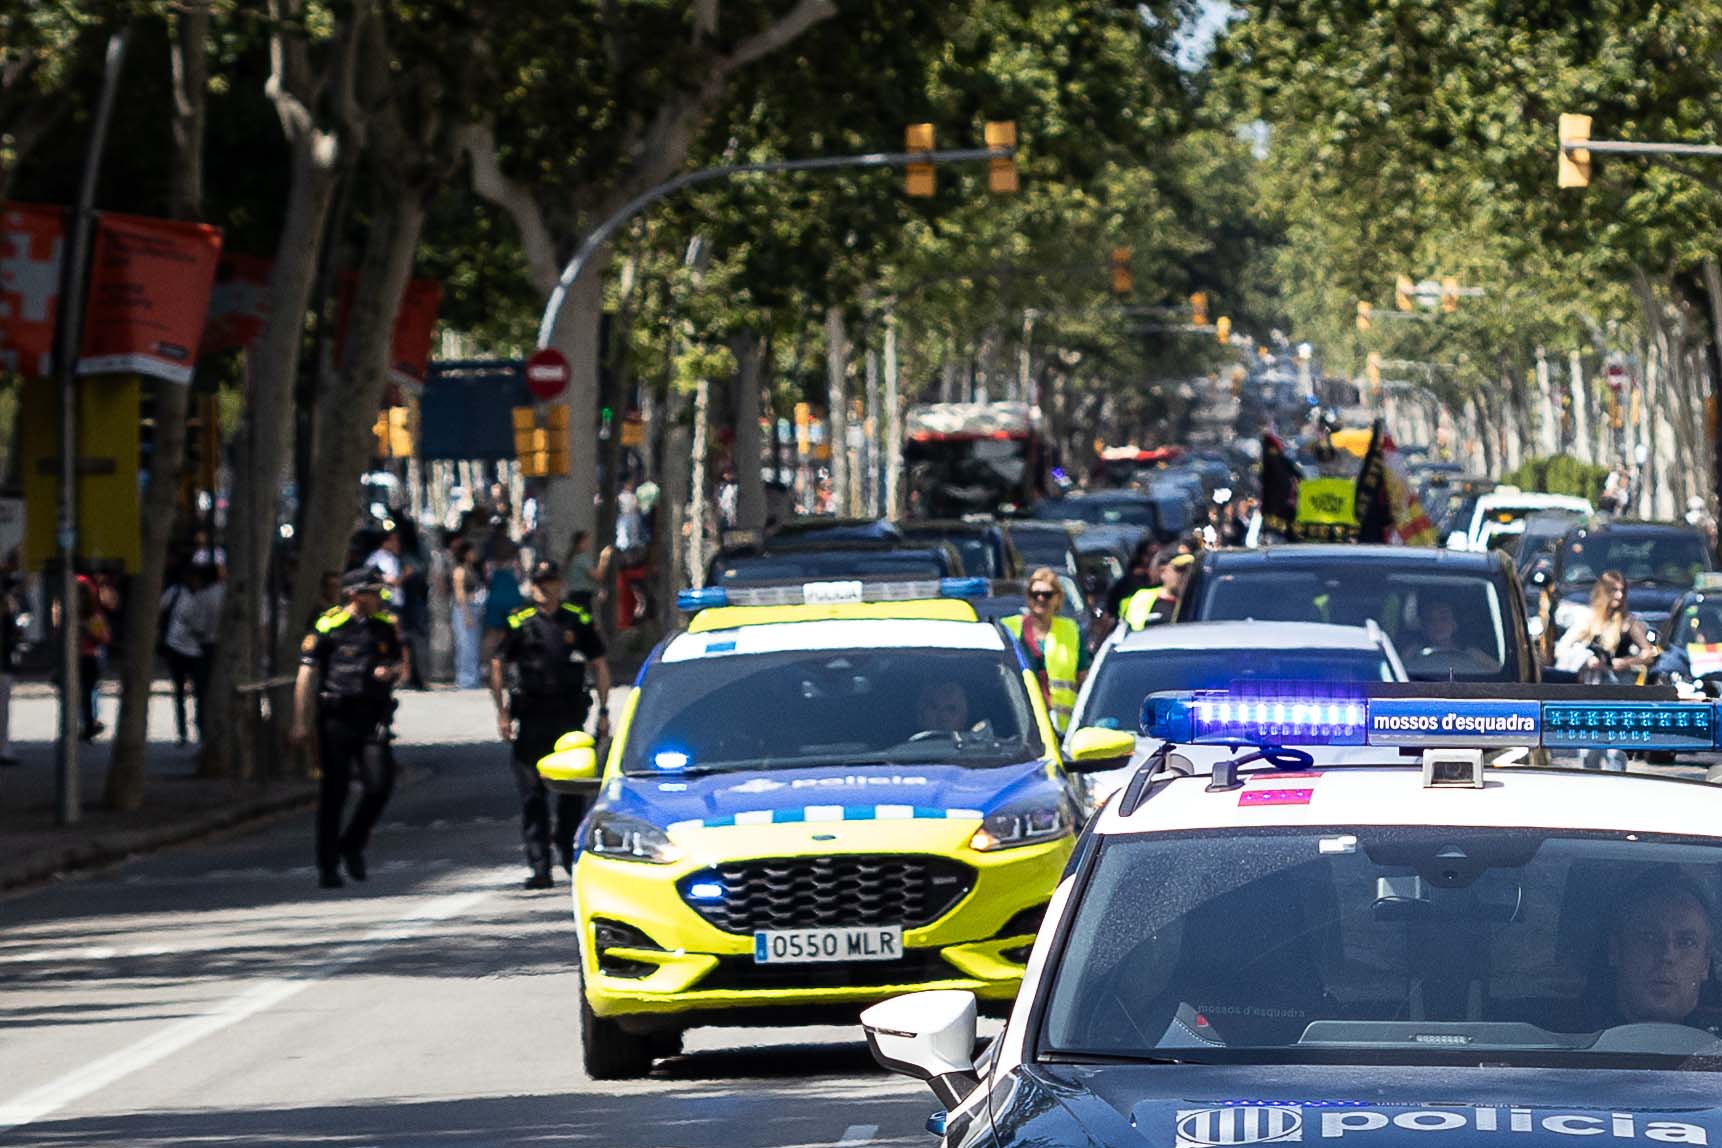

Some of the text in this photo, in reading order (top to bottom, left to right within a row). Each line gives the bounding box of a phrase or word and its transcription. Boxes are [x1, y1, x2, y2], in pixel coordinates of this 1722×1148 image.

[1373, 713, 1536, 734] mossos d'esquadra
[773, 931, 895, 958] 0550 MLR
[1321, 1108, 1709, 1146] policia
